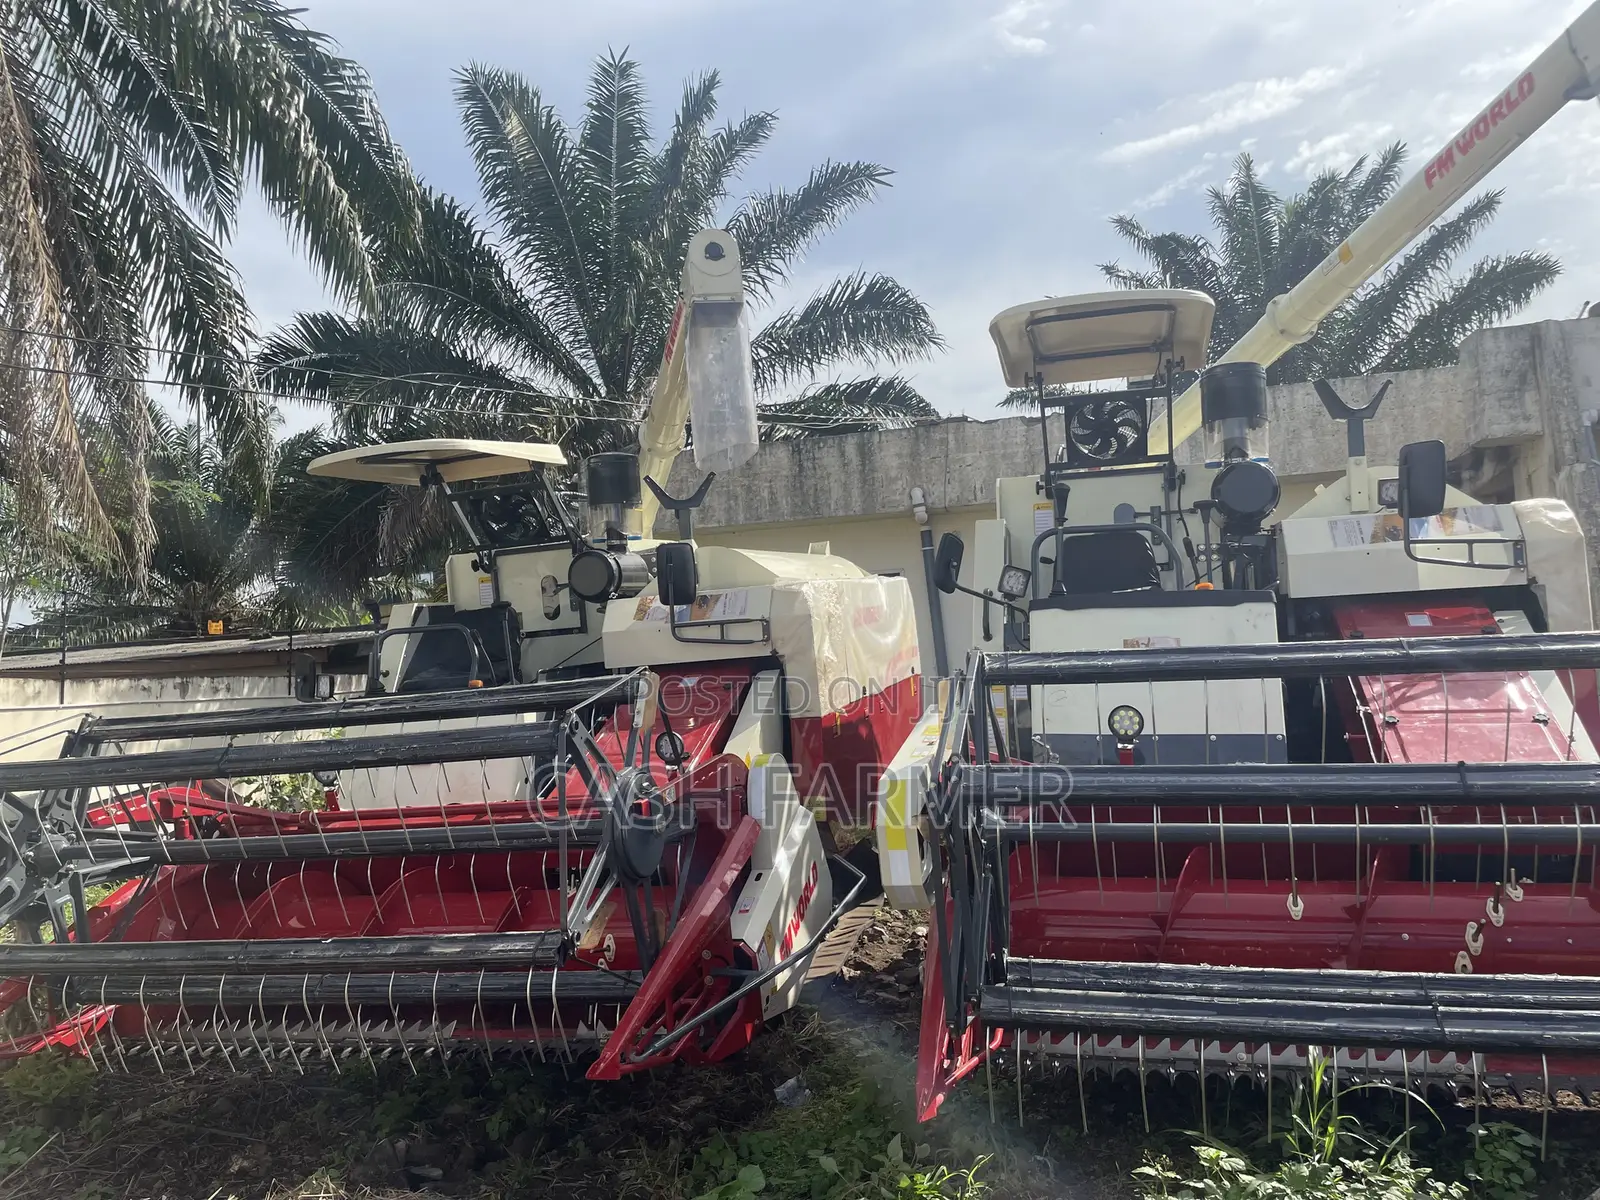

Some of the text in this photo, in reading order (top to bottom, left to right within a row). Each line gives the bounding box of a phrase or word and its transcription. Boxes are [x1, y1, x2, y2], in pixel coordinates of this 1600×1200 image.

[1424, 71, 1536, 190] FM WORLD
[791, 861, 818, 937] WORLD
